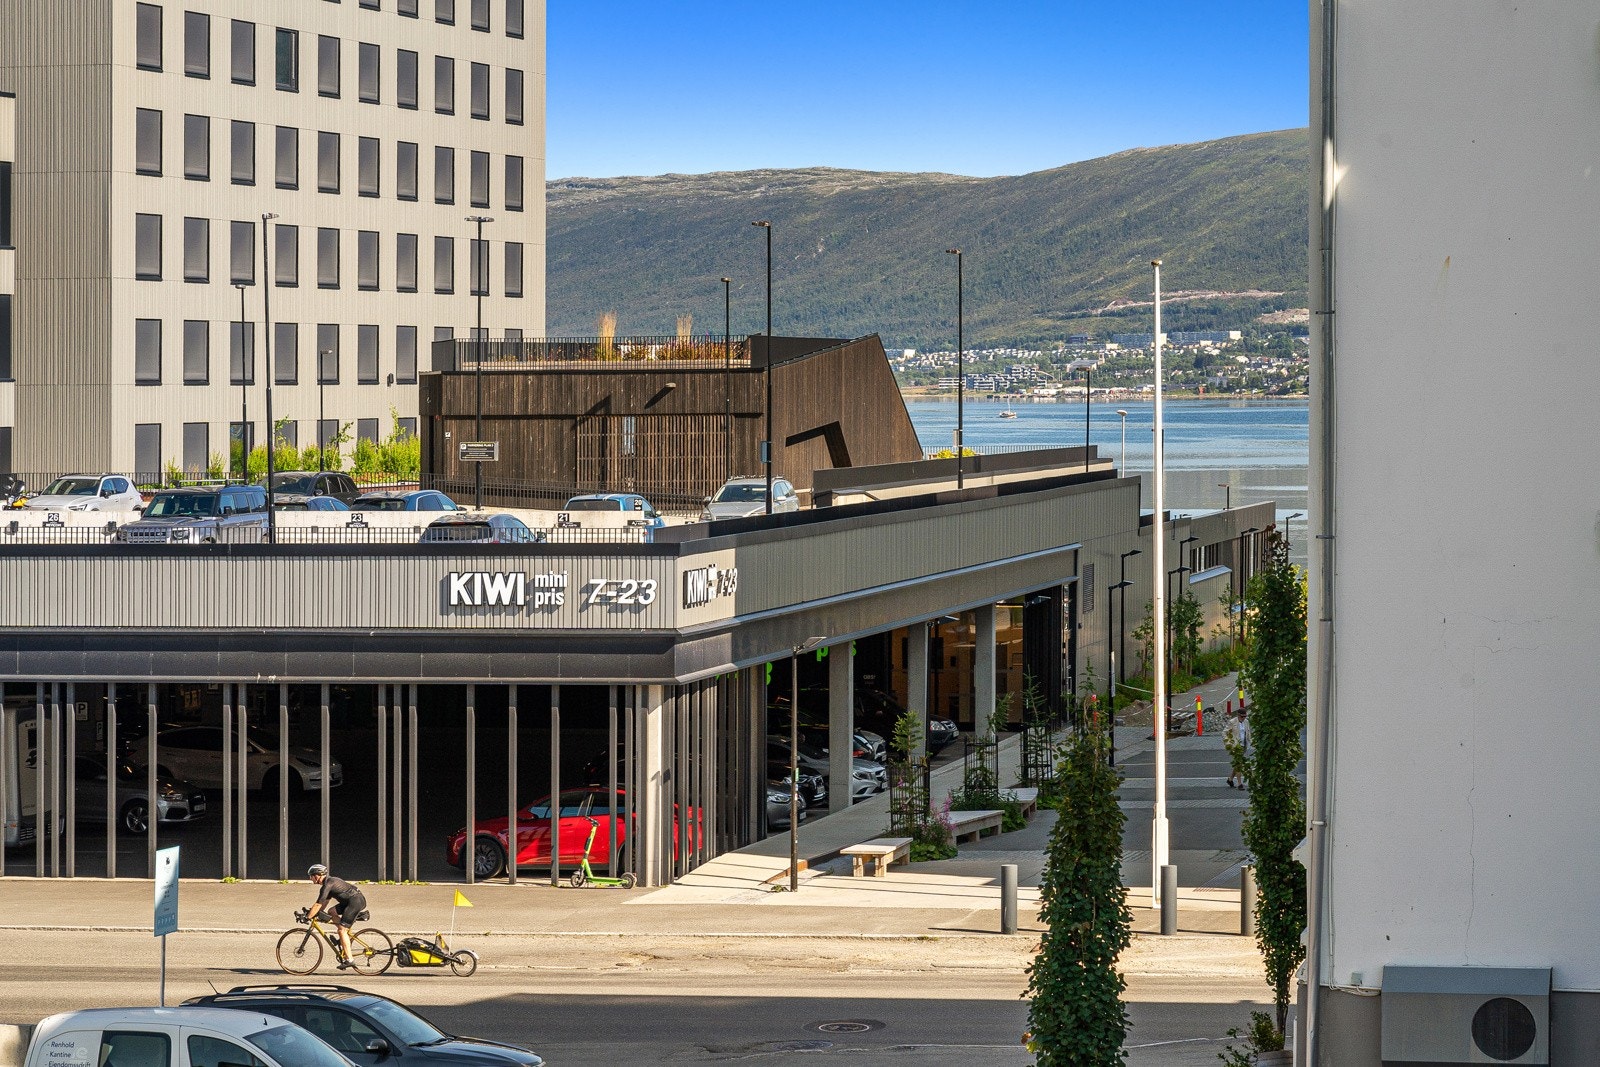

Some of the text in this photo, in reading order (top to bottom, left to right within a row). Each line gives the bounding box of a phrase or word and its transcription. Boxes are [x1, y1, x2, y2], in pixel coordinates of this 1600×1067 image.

[48, 513, 59, 522] 26
[352, 514, 362, 522] 23
[558, 513, 569, 522] 21
[534, 571, 568, 588] mini
[688, 568, 707, 604] KIWI
[449, 572, 658, 606] KIWI 7-23
[534, 588, 565, 609] pris
